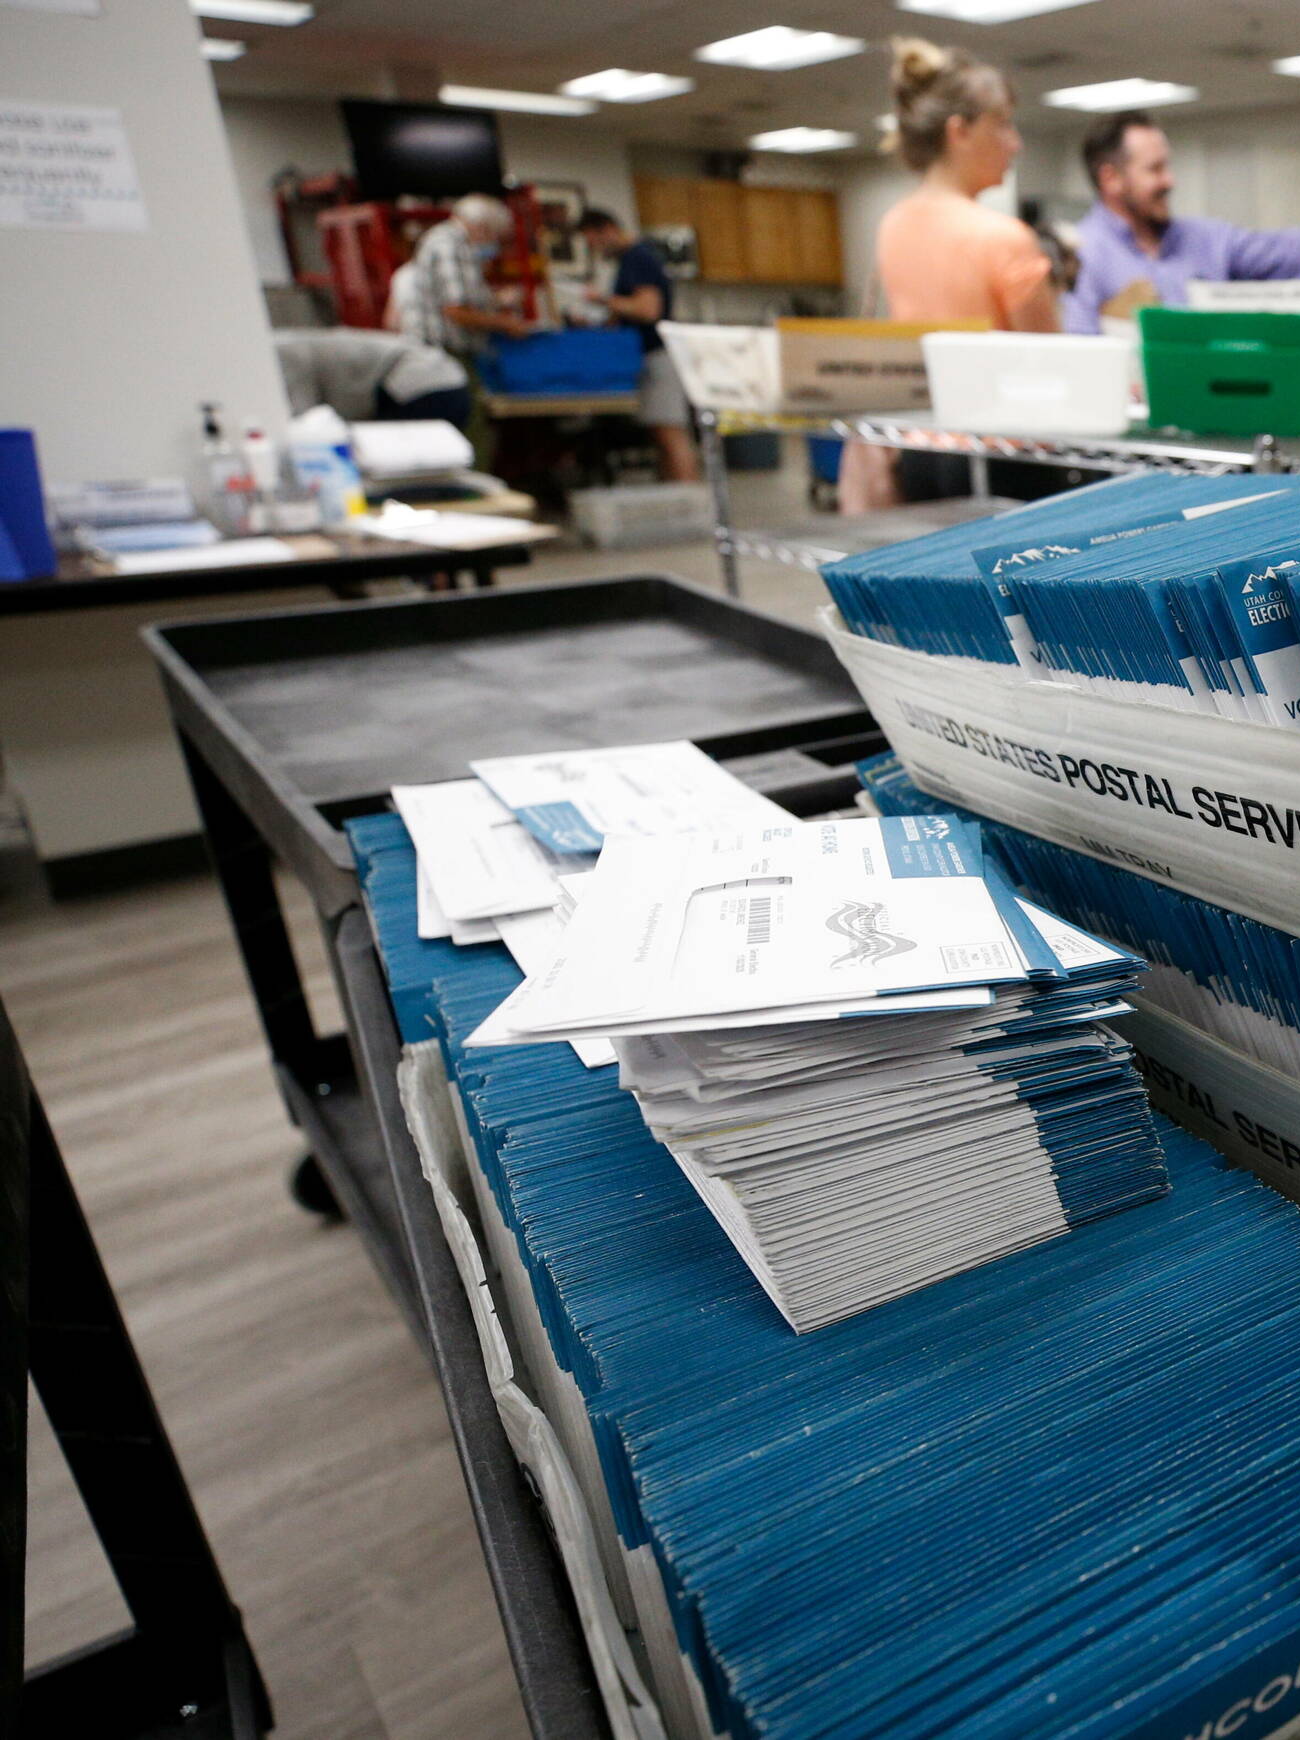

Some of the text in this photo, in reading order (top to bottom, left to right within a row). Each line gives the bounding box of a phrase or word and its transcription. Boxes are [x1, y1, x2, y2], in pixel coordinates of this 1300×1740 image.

[1243, 595, 1266, 607] UTAH
[897, 700, 968, 748] UNITED
[963, 722, 1062, 783] STATES
[1056, 752, 1193, 821] POSTAL
